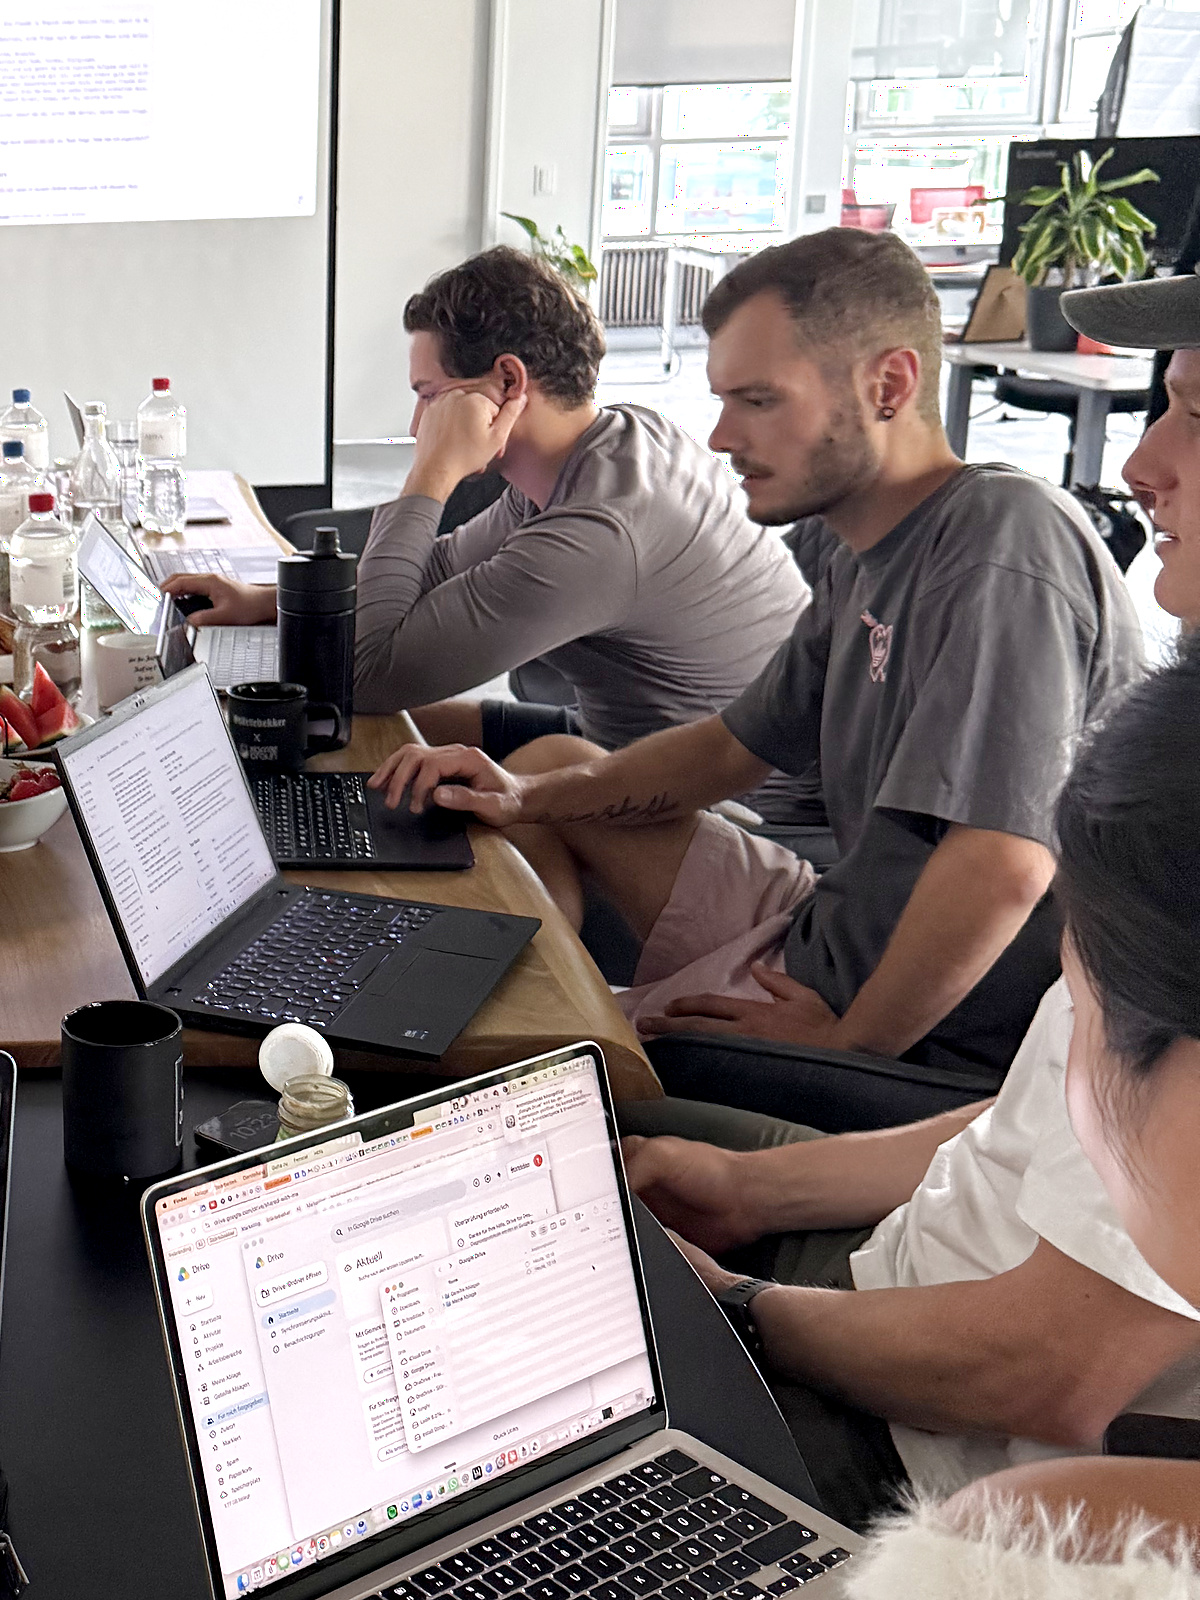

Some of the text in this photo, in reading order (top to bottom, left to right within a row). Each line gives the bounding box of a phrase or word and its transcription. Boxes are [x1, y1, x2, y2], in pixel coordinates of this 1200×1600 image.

[267, 1252, 285, 1263] Drive
[356, 1250, 383, 1269] Aktuell
[192, 1263, 210, 1274] Drive
